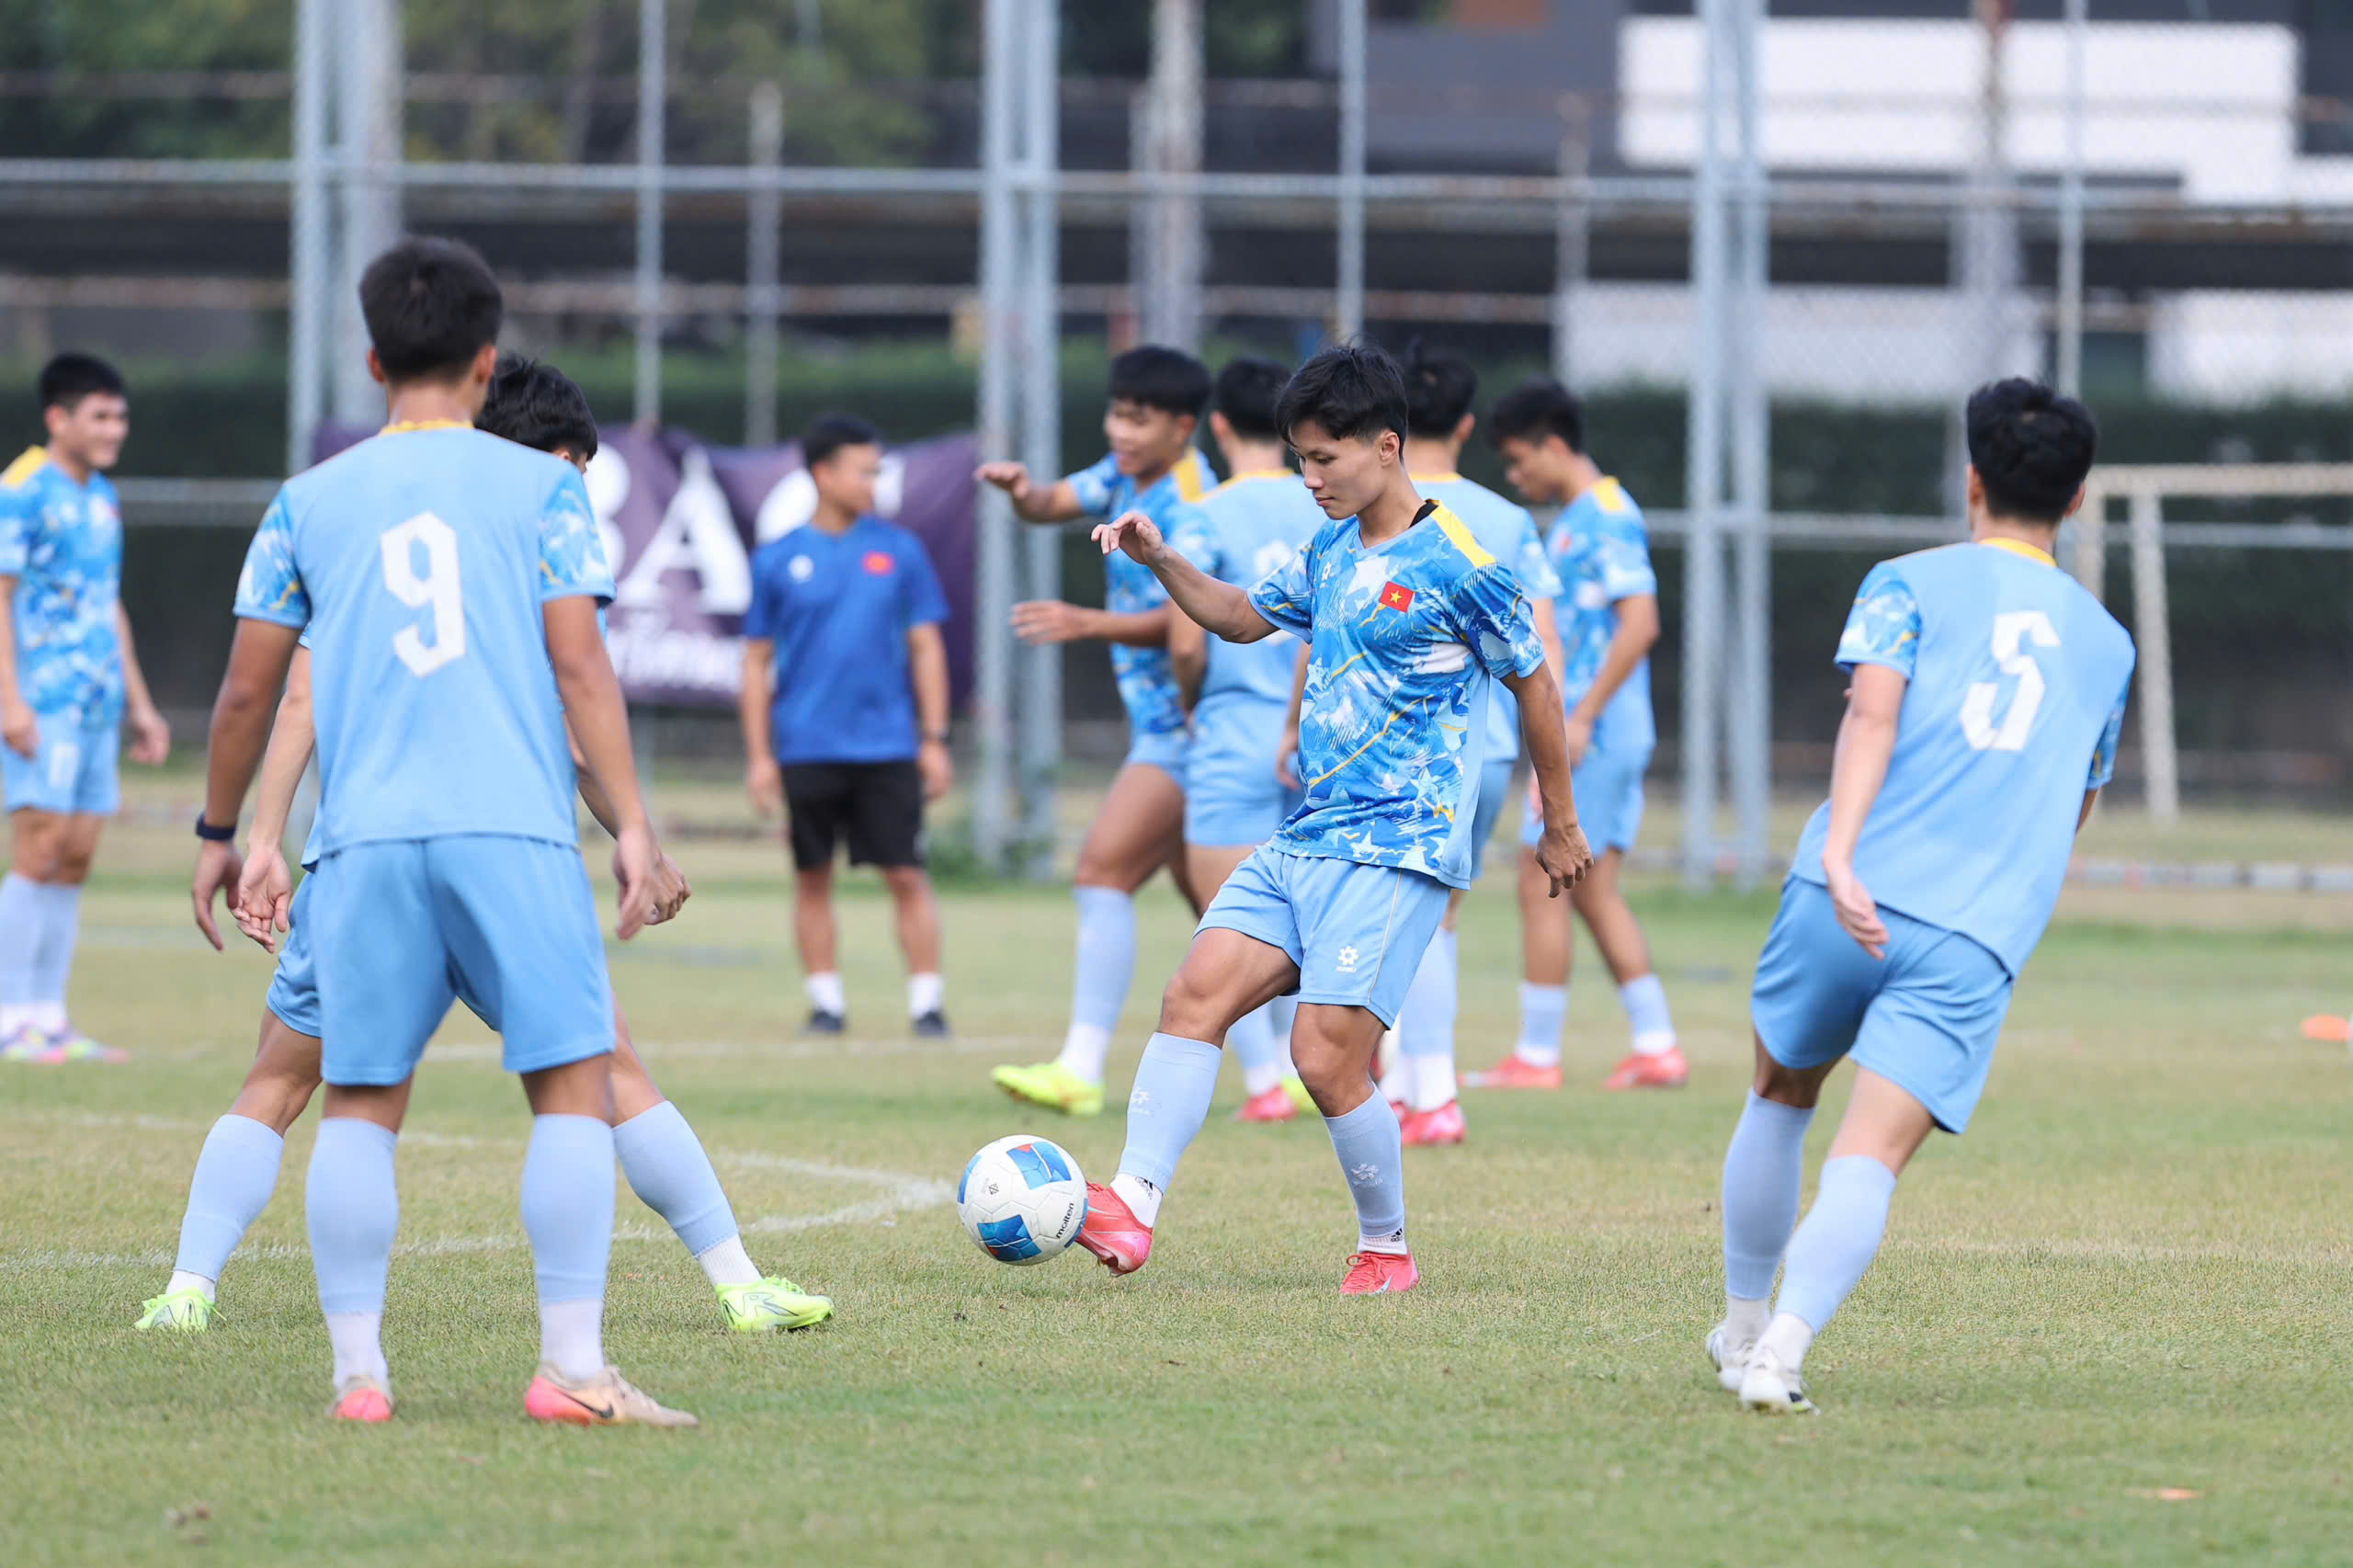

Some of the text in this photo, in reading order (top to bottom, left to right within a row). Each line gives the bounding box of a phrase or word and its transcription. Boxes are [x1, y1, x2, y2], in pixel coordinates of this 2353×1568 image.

[381, 510, 466, 678] 9
[1959, 610, 2062, 751] 5
[1056, 1202, 1074, 1239] molten
